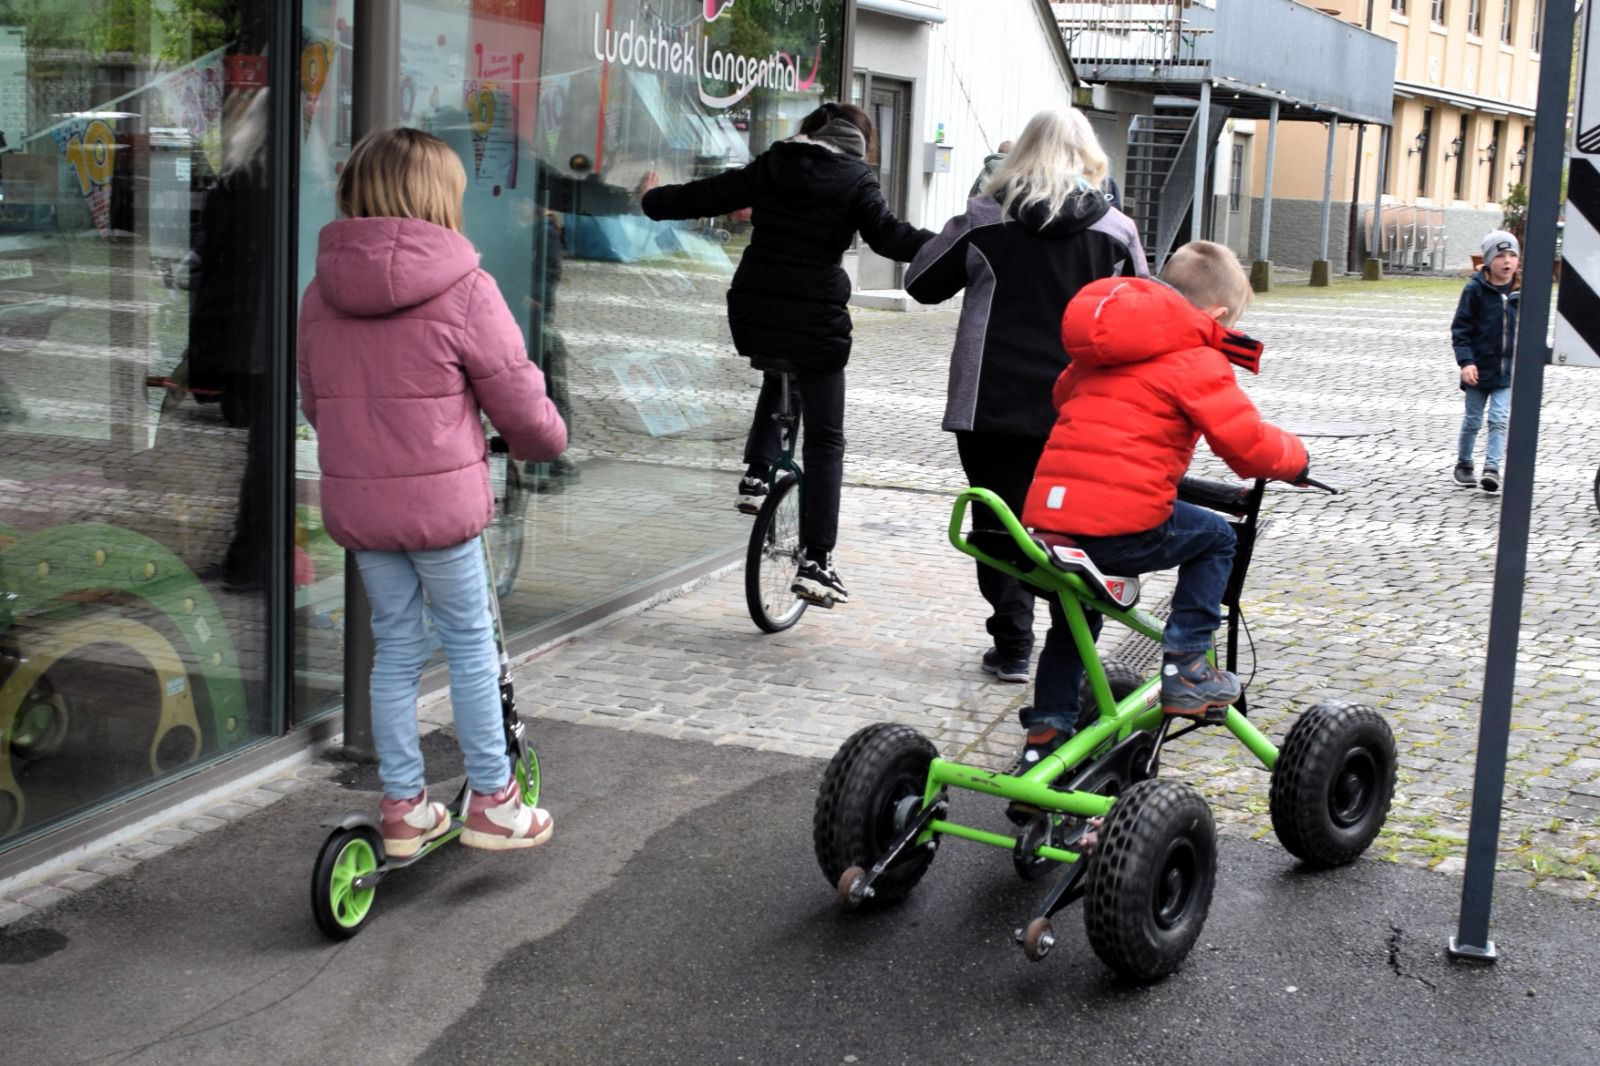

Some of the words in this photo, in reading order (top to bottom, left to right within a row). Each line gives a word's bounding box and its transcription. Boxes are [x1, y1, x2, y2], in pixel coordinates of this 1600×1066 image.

[593, 12, 694, 75] Ludothek
[702, 36, 801, 95] Langenthal
[64, 119, 117, 197] 10
